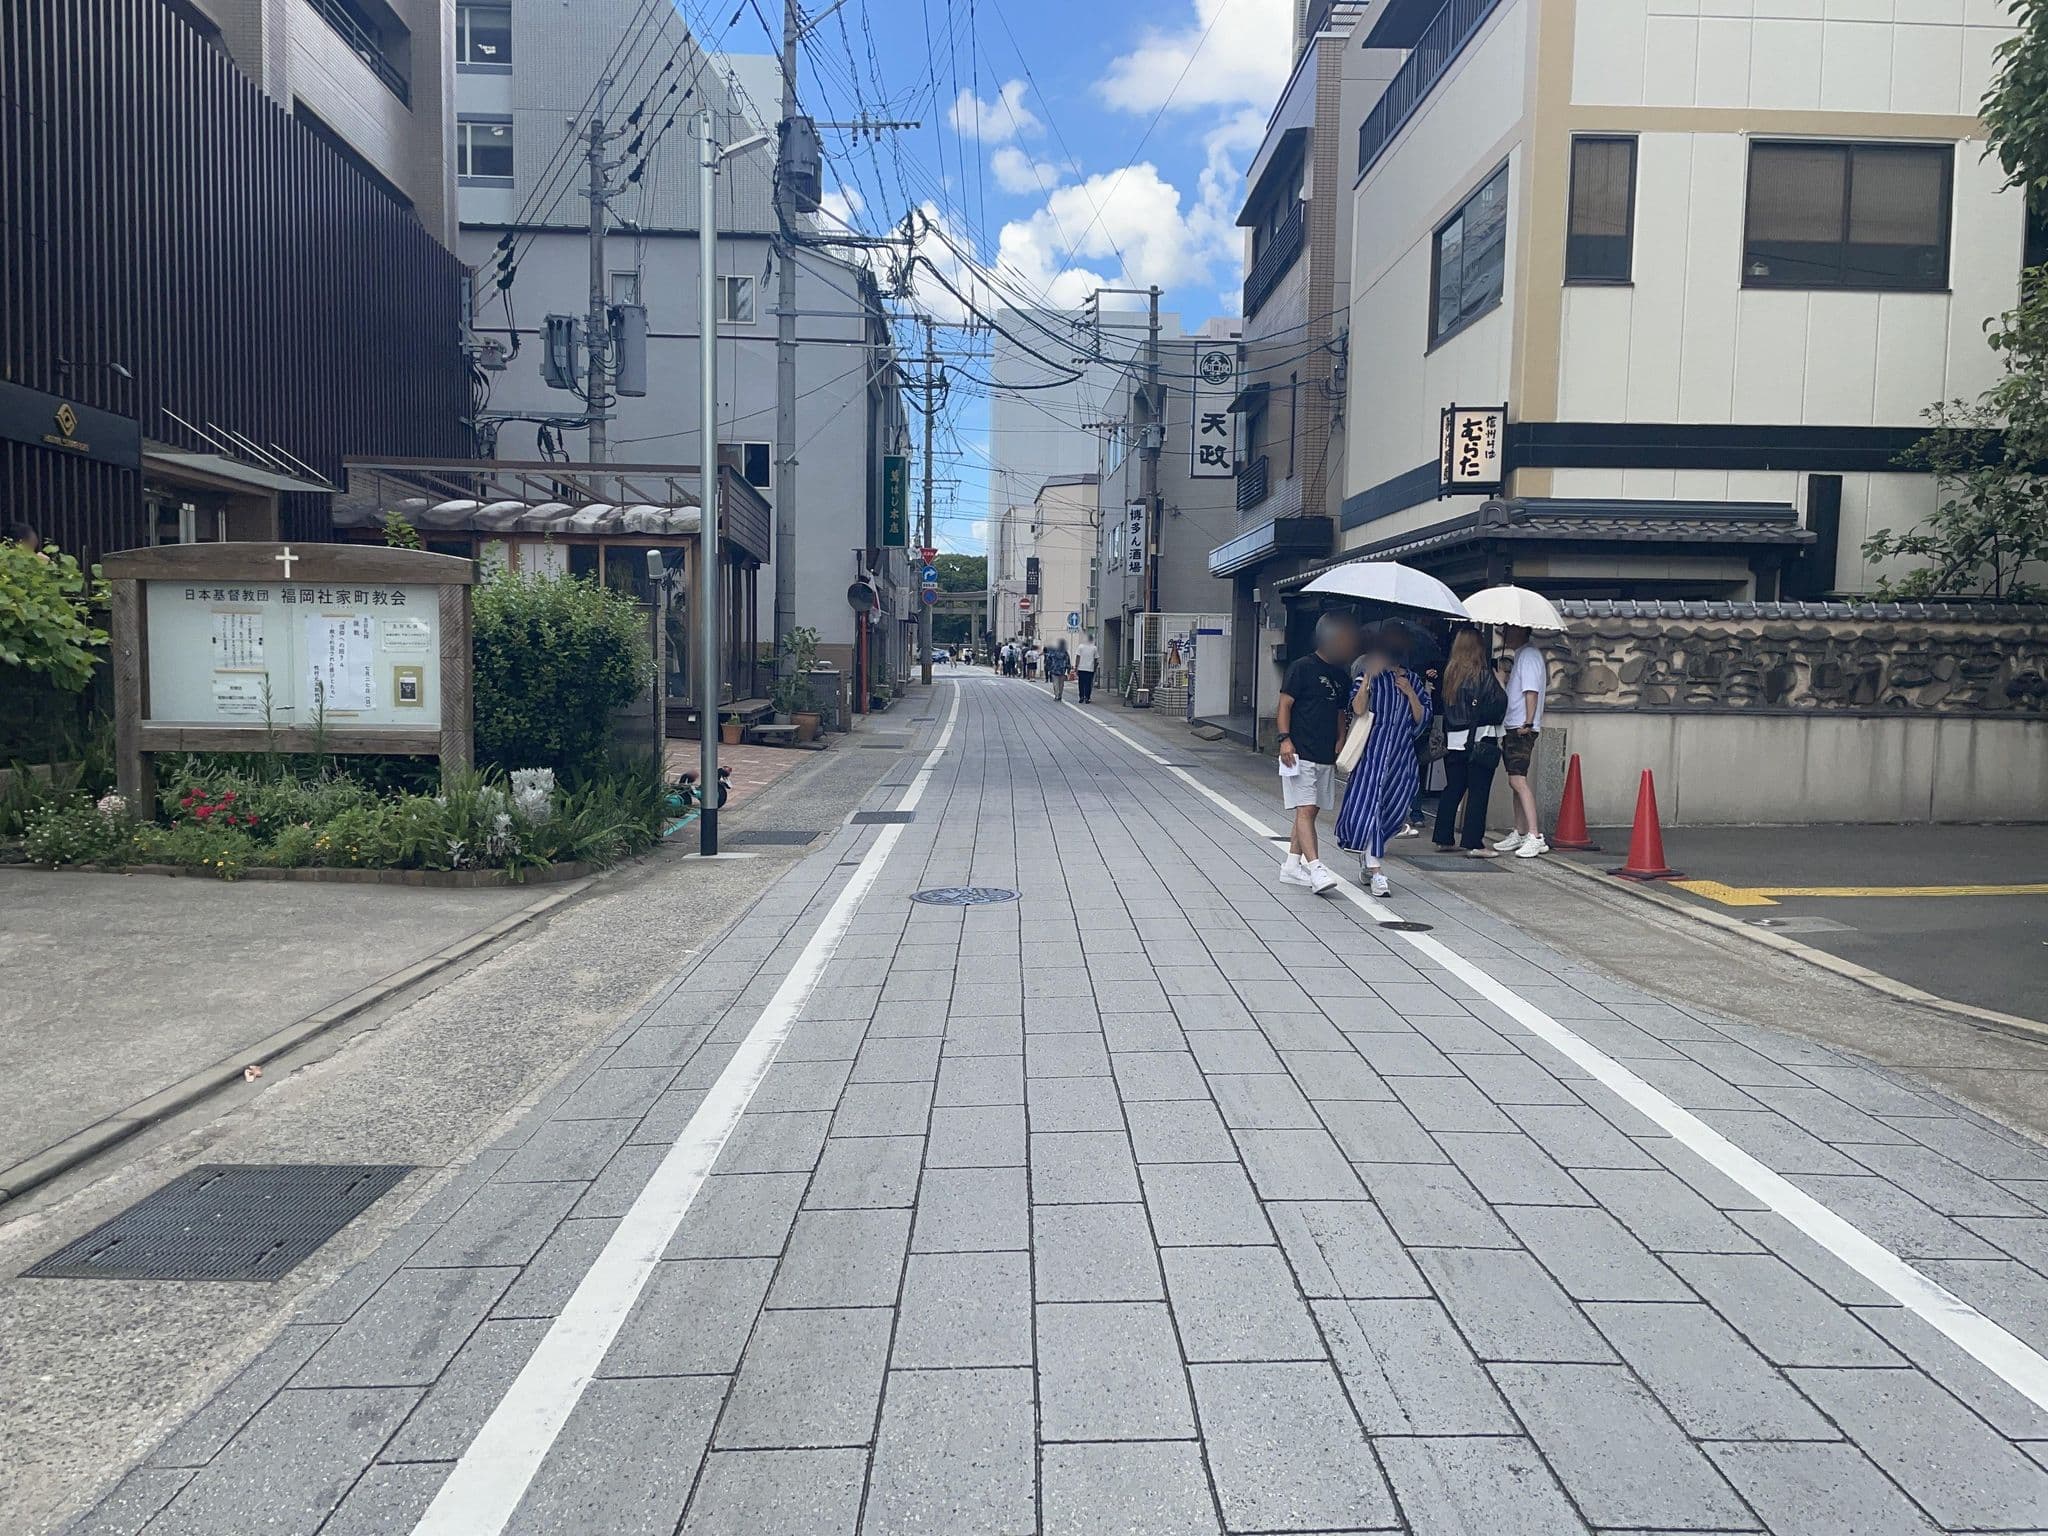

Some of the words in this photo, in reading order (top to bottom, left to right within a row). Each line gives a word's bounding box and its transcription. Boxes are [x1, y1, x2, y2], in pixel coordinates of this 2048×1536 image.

[1200, 413, 1230, 468] 天政
[1459, 418, 1483, 477] むらた
[1128, 508, 1144, 573] 博多ん酒場
[185, 588, 269, 602] 日本基督教団
[281, 589, 406, 606] 福岡社家町教会
